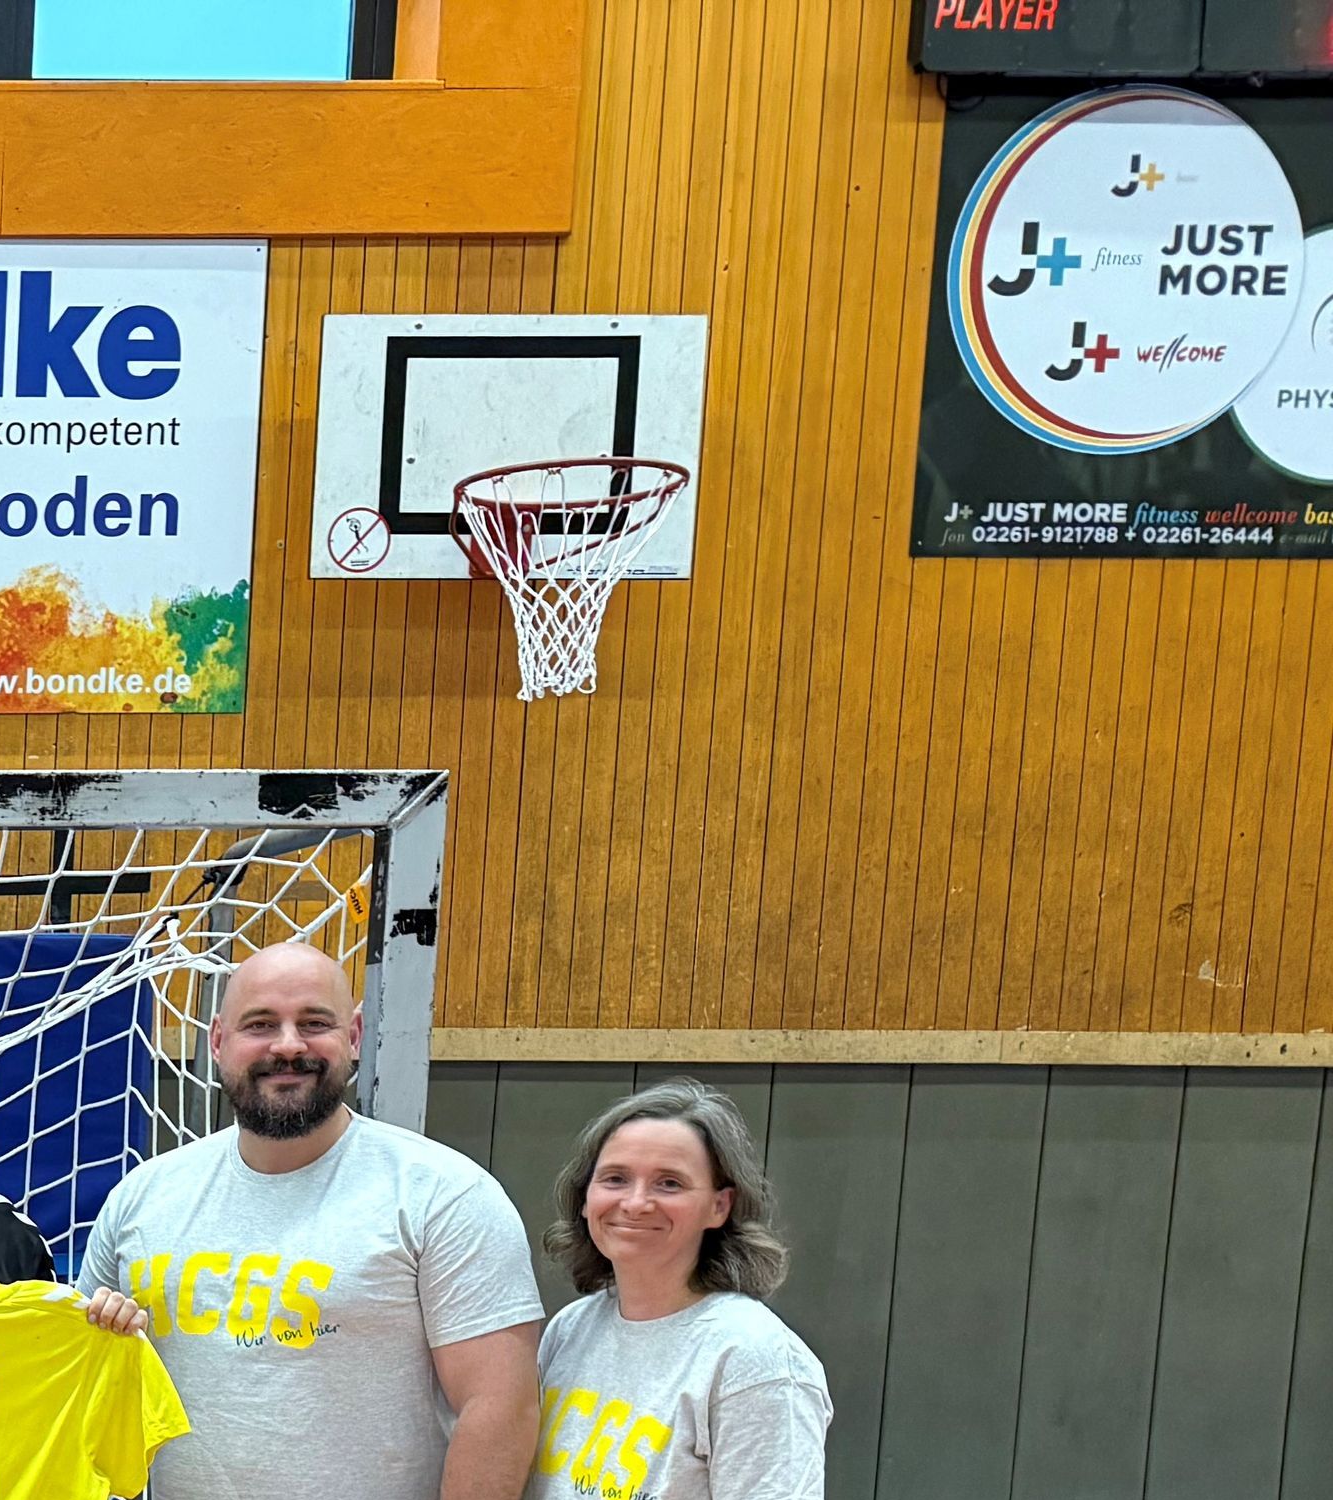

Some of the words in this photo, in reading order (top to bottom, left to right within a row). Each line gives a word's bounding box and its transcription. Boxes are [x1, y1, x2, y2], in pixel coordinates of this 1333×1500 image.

[933, 0, 1059, 31] PLAYER
[1161, 223, 1274, 256] JUST
[1091, 247, 1143, 272] fitness
[1158, 263, 1289, 296] MORE
[980, 502, 1046, 523] JUST
[1052, 502, 1128, 523] MORE
[1133, 502, 1199, 530] fitness
[1204, 502, 1298, 525] wellcome
[1142, 526, 1274, 545] 02261-26444
[129, 1252, 335, 1350] HCGS
[235, 1327, 267, 1349] Wir
[276, 1328, 304, 1343] von
[309, 1320, 341, 1338] hier
[573, 1473, 595, 1496] Wir
[602, 1485, 623, 1500] von
